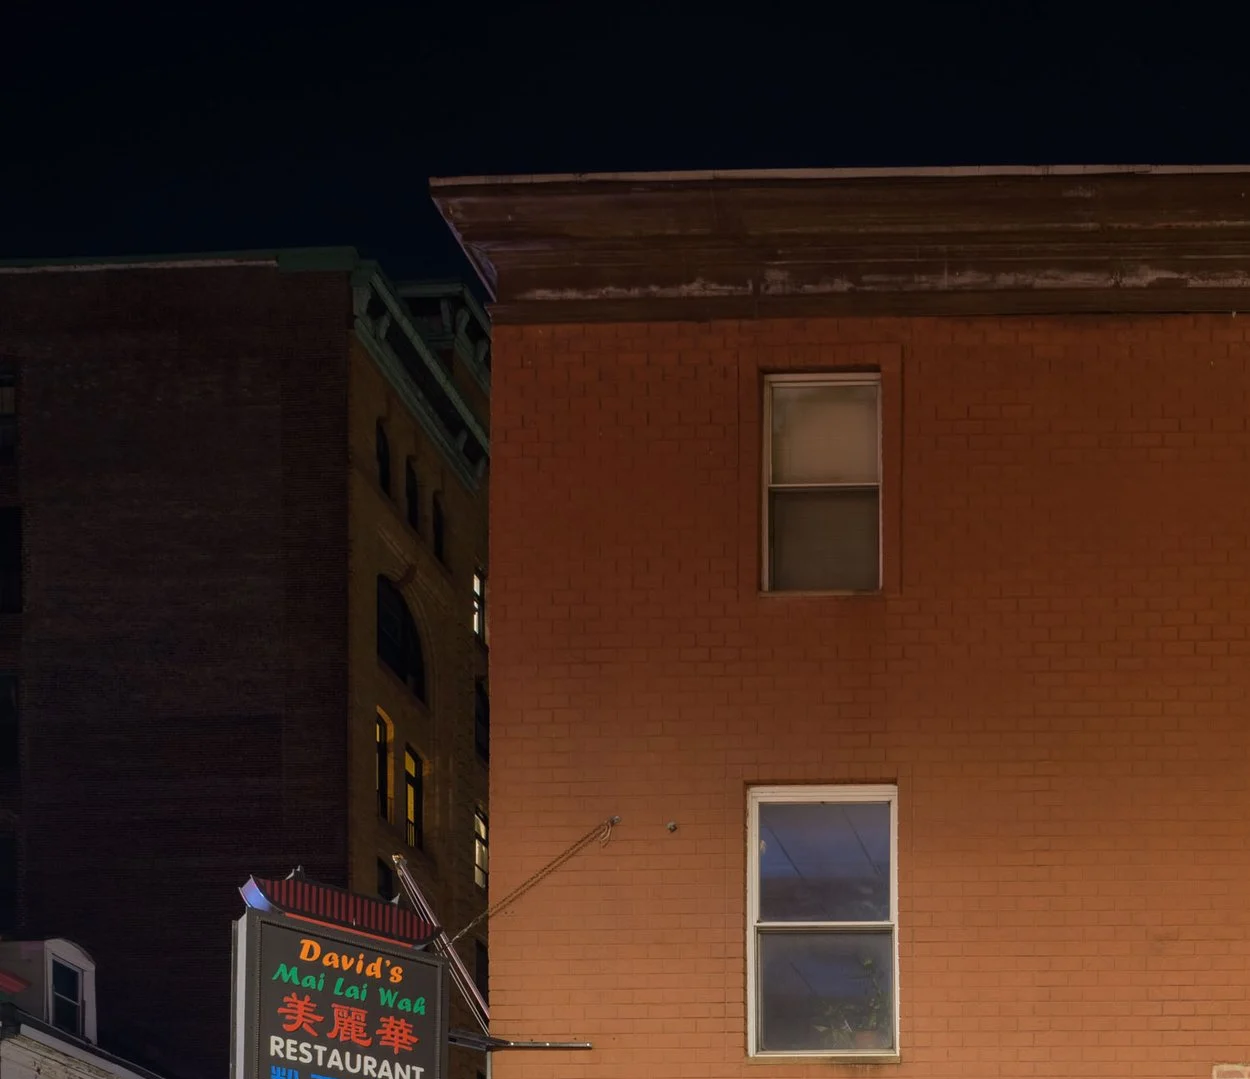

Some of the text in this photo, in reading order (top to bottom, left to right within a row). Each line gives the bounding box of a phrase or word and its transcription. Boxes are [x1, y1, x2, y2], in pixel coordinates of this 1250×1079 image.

[300, 939, 403, 983] David's
[272, 963, 426, 1015] Mai Lai Wah
[277, 992, 420, 1055] 美麗華
